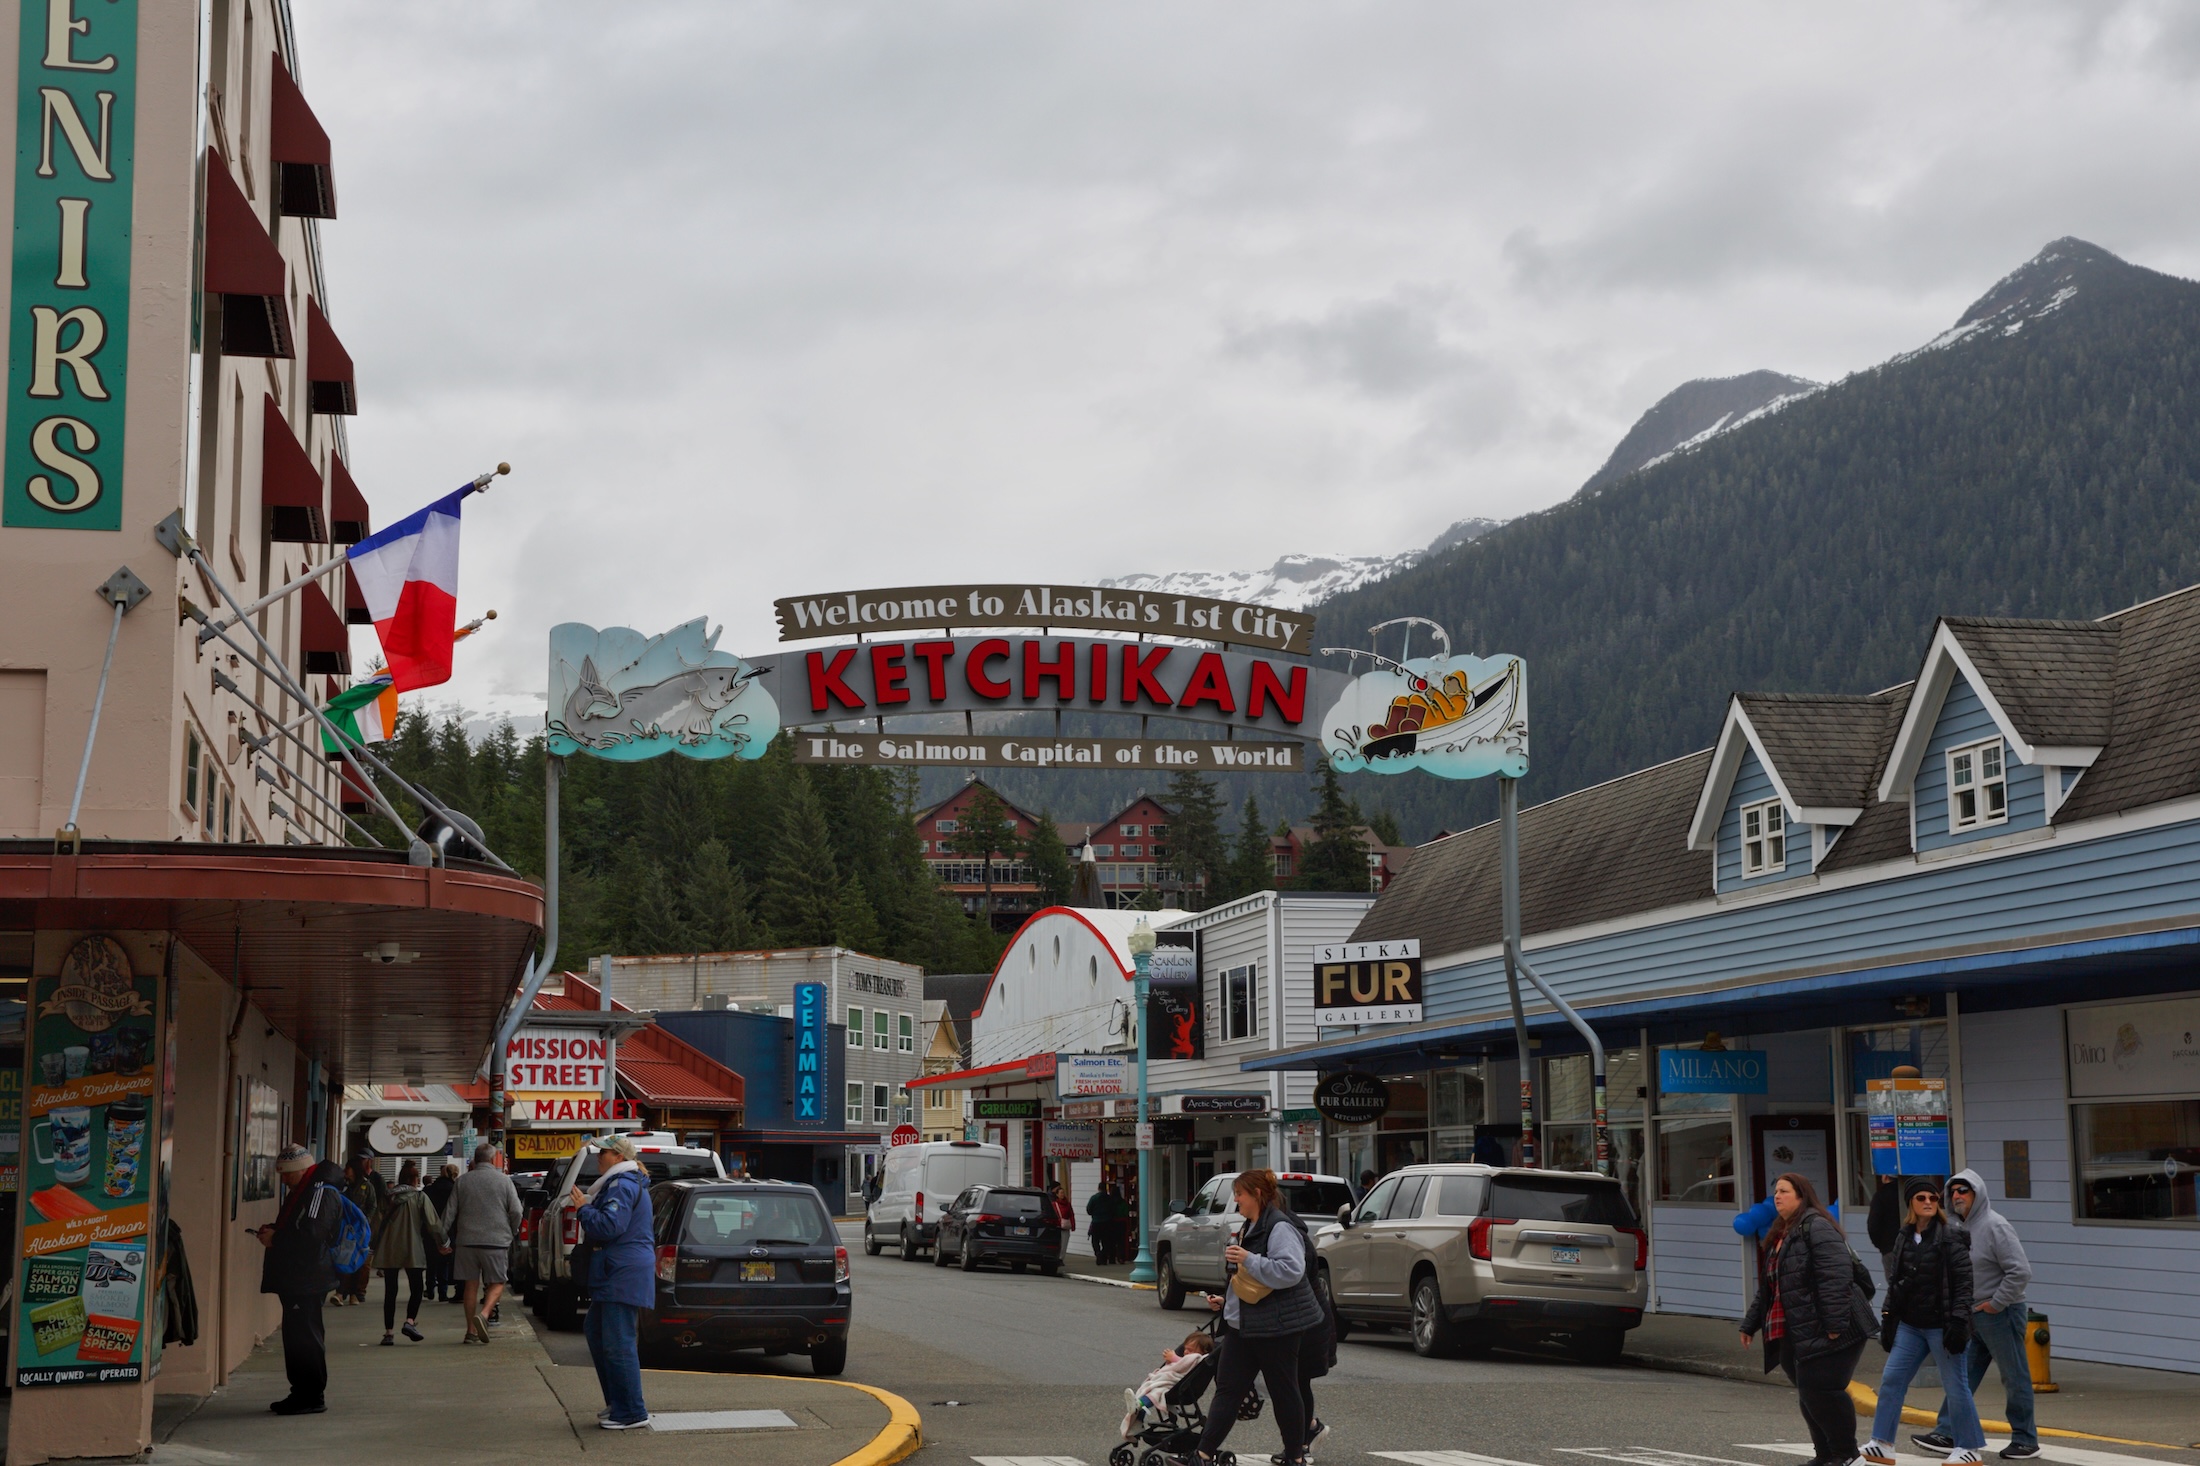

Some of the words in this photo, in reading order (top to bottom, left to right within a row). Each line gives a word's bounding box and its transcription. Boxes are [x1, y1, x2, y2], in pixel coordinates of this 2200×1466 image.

[791, 595, 957, 629] Welcome
[967, 590, 1004, 616] to
[1015, 587, 1160, 622] Alaska's
[1172, 600, 1223, 631] 1st
[1232, 607, 1300, 650] City
[805, 638, 1308, 724] KETCHIKAN
[807, 738, 863, 759] The
[878, 739, 986, 761] Salmon
[1001, 742, 1100, 766] Capital
[1115, 744, 1141, 764] of
[1155, 745, 1198, 764] the
[1211, 746, 1292, 766] World
[1325, 944, 1409, 960] SITKA
[1322, 961, 1413, 1005] FUR
[57, 987, 87, 1001] INSIDE
[1325, 1009, 1414, 1021] GALLERY
[506, 1038, 607, 1060] MISSION
[798, 986, 817, 1116] SEAMAX
[1074, 1058, 1105, 1066] Salmon
[1108, 1058, 1123, 1066] Etc.
[1668, 1058, 1759, 1079] MILANO
[511, 1064, 604, 1085] STREET
[1077, 1085, 1120, 1093] SALMON
[1331, 1074, 1374, 1095] Sitka
[32, 1091, 79, 1108] Alaska
[83, 1077, 153, 1098] Drinkware
[1187, 1099, 1210, 1108] Arctic
[1234, 1098, 1260, 1109] Gallery
[1320, 1096, 1340, 1106] FUR
[1342, 1097, 1385, 1107] GALLERY
[535, 1099, 642, 1120] MARKET
[1334, 1112, 1372, 1121] KETCHIKAN
[1048, 1123, 1078, 1131] Salmon
[518, 1136, 576, 1151] SALMON
[892, 1134, 918, 1145] STOP
[1051, 1149, 1092, 1157] SALMON
[26, 1233, 87, 1253] Alaskan
[90, 1221, 146, 1240] Salmon
[30, 1274, 79, 1284] SALMON
[28, 1283, 76, 1294] SPREAD
[38, 1313, 84, 1336] SALMON
[48, 1310, 72, 1324] DILL
[40, 1323, 85, 1346] SPREAD
[87, 1328, 134, 1343] SALMON
[84, 1338, 130, 1352] SPREAD
[20, 1372, 53, 1385] LOCALLY
[55, 1371, 84, 1383] OWNED
[100, 1368, 138, 1381] OPERATED
